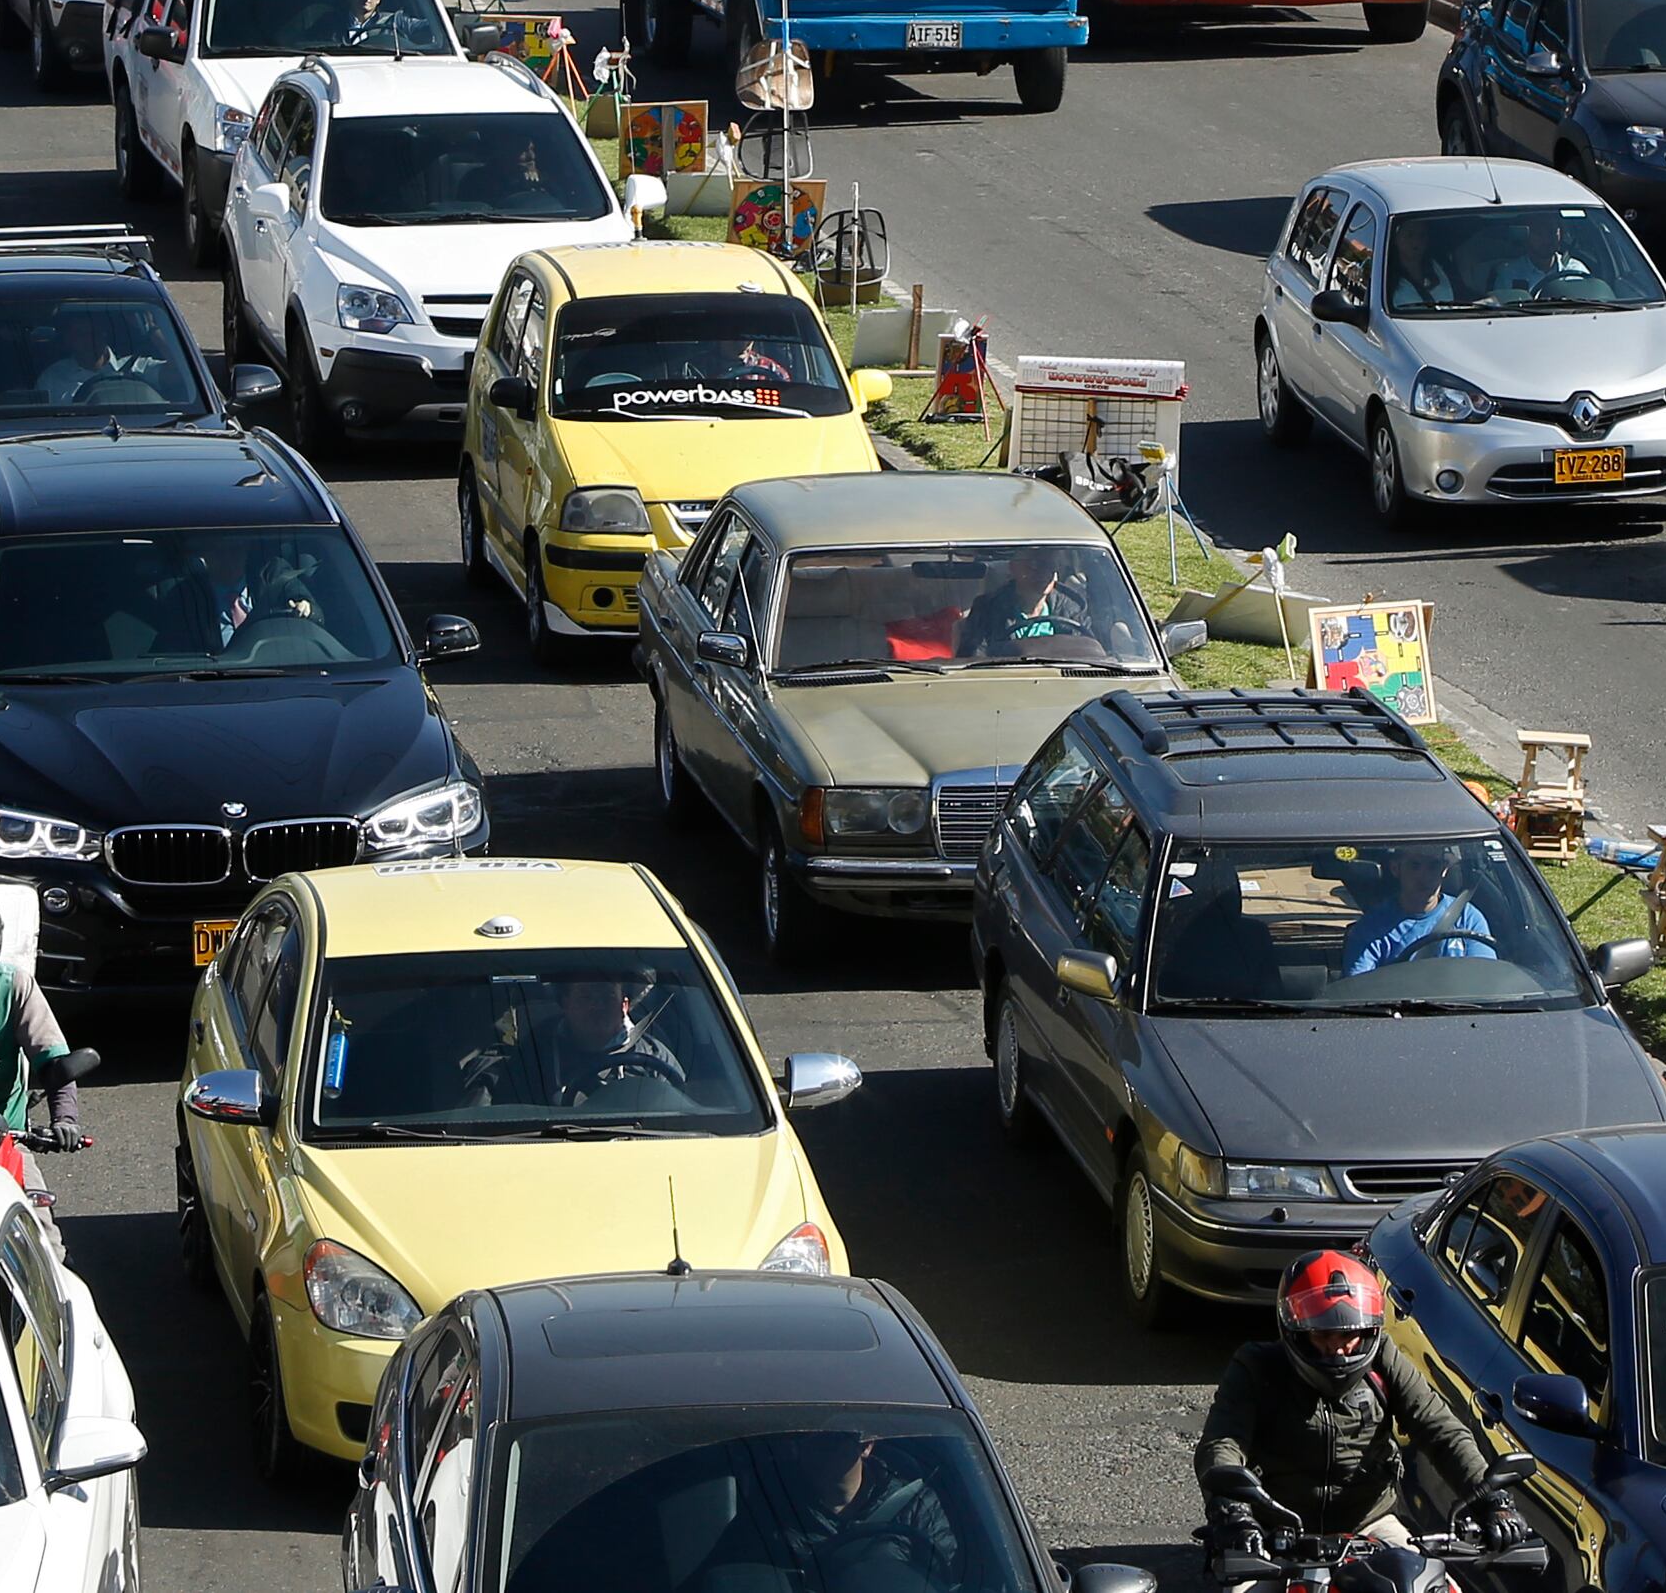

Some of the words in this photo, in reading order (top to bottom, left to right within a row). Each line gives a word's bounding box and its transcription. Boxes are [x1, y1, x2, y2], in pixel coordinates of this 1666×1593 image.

[1048, 371, 1148, 388] PROGRAMADOR
[1557, 454, 1622, 475] IVZ-288
[494, 925, 513, 934] TAXI
